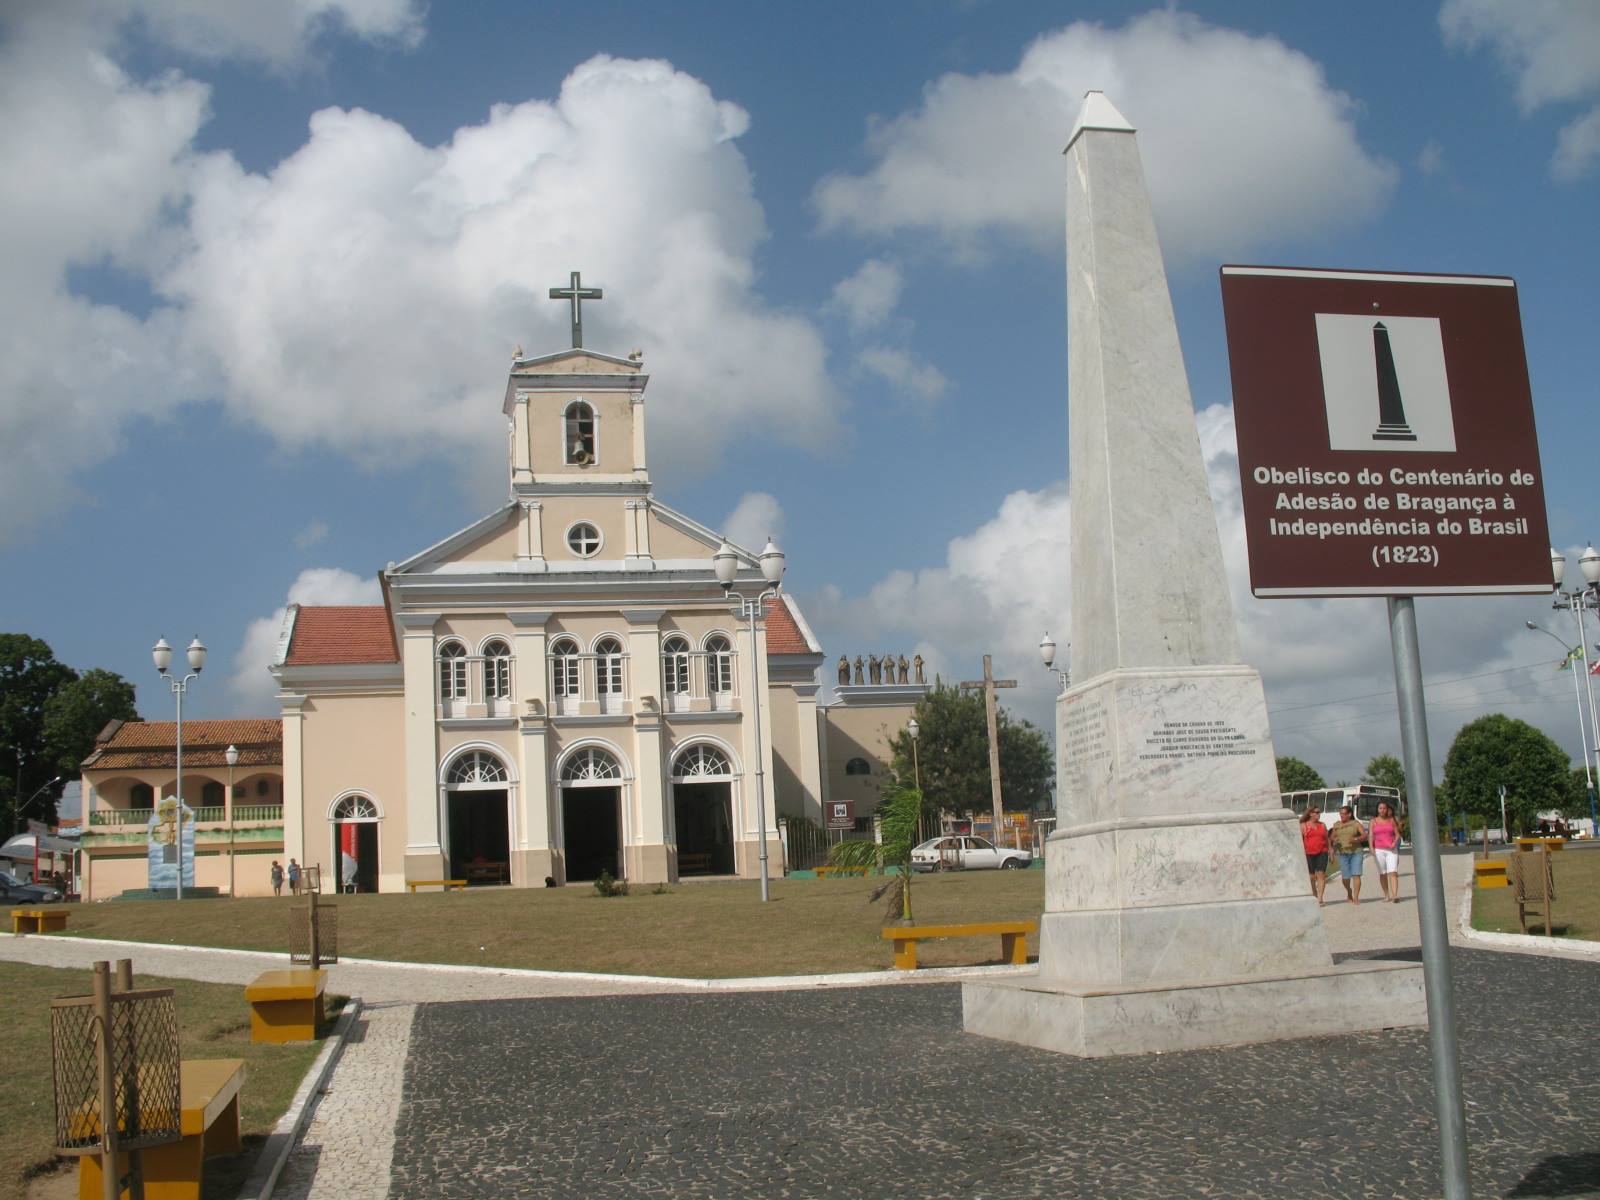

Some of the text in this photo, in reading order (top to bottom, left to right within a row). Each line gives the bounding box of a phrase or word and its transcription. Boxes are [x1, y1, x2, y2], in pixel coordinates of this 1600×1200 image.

[1254, 467, 1534, 485] Obelisco do Centenário de
[1276, 493, 1515, 514] Adesão de Bragança à
[1270, 518, 1528, 539] Independência do Brasil
[1372, 546, 1439, 567] (1823)
